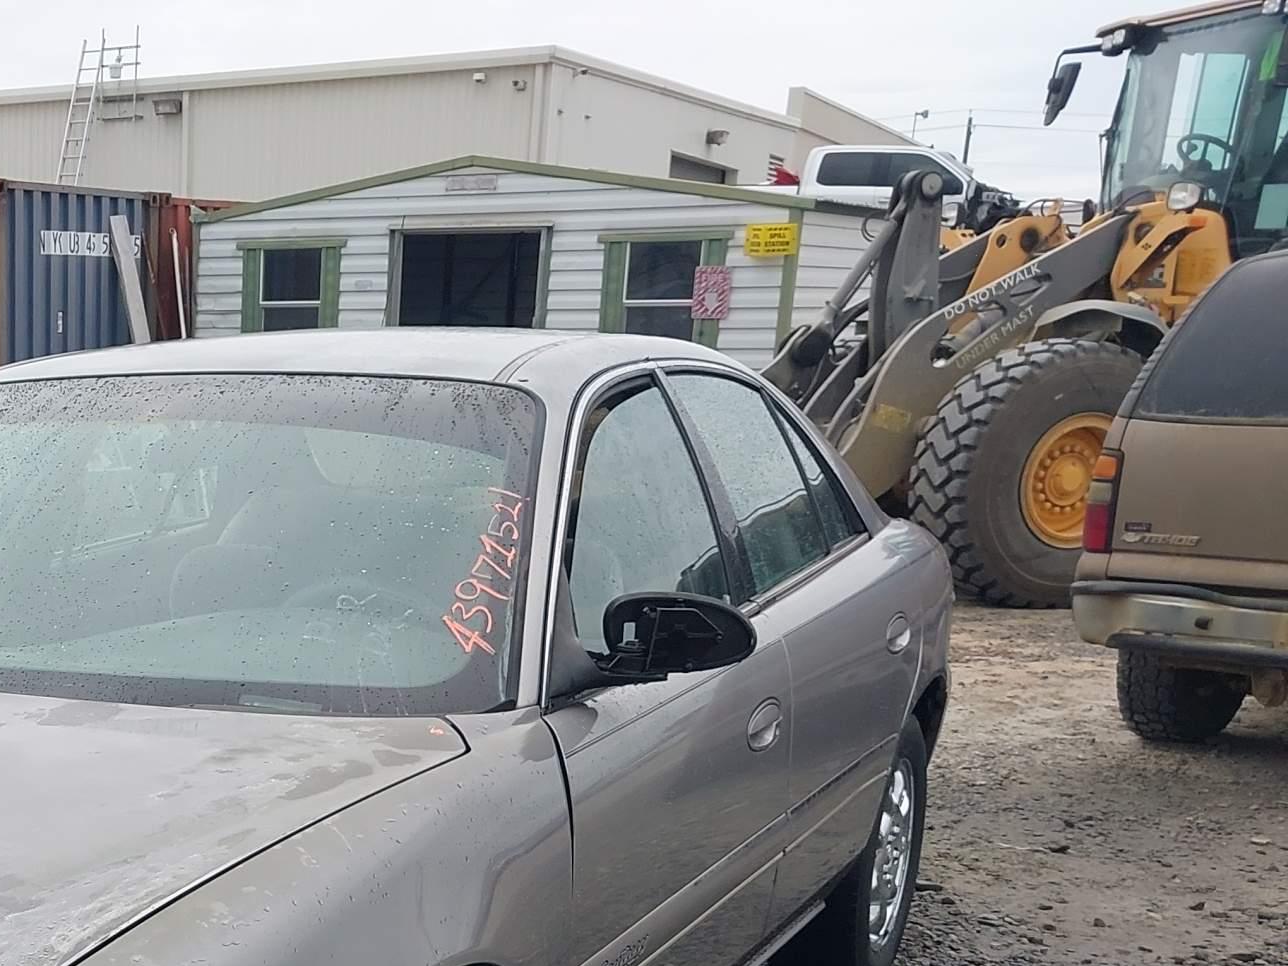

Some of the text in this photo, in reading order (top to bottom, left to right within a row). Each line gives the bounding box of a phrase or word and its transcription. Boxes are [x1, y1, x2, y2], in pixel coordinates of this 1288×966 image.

[944, 263, 1041, 320] DO NOT WALK
[954, 304, 1034, 369] UNDER MAST
[442, 487, 523, 656] 43971521
